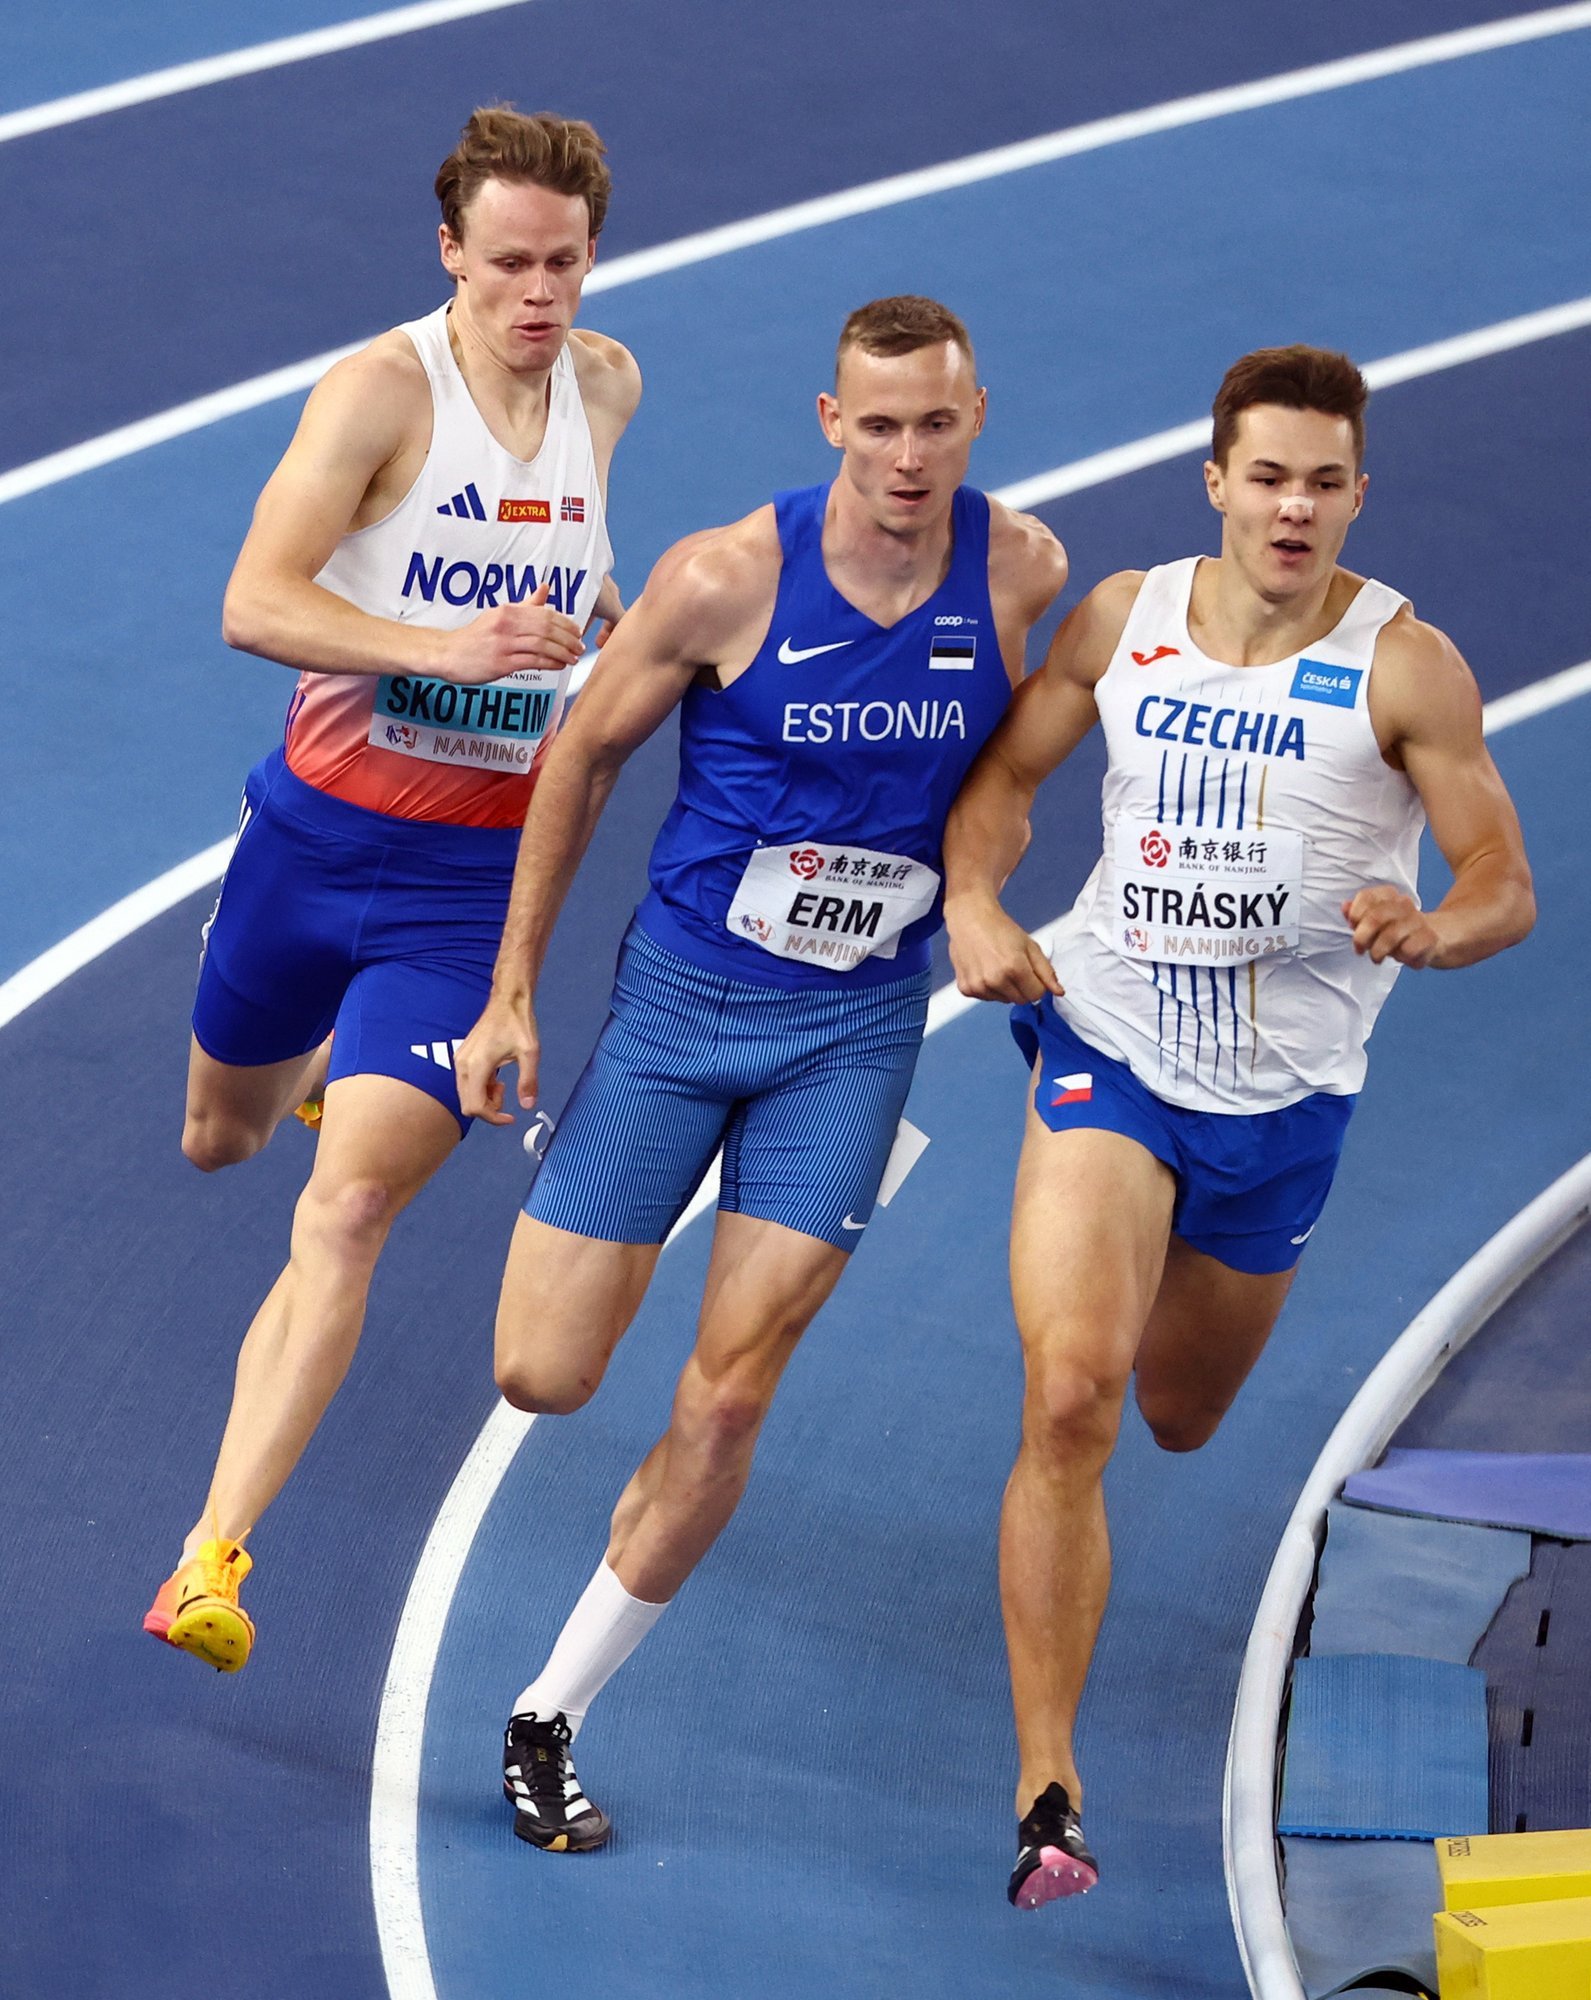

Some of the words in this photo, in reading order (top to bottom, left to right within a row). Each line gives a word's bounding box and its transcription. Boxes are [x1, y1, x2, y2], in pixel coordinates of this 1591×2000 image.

[512, 506, 547, 518] EXTRA
[401, 551, 587, 615] NORWAY
[934, 616, 963, 627] coop
[1302, 671, 1338, 688] ČESKÁ
[387, 675, 551, 733] SKOTHEIM
[782, 700, 966, 743] ESTONIA
[1135, 695, 1305, 761] CZECHIA
[433, 735, 528, 764] NANJING
[1178, 836, 1267, 863] 南京银行
[829, 854, 913, 880] 南京银行
[1179, 862, 1205, 871] BANK
[1208, 864, 1220, 872] OF
[1224, 866, 1267, 875] NANJING
[825, 875, 849, 884] BANK
[852, 878, 863, 886] OF
[866, 880, 904, 890] NANJING
[786, 891, 884, 939] ERM
[1123, 882, 1290, 930] STRÁSKÝ
[784, 934, 867, 963] NANJIN
[1163, 934, 1259, 960] NANJING
